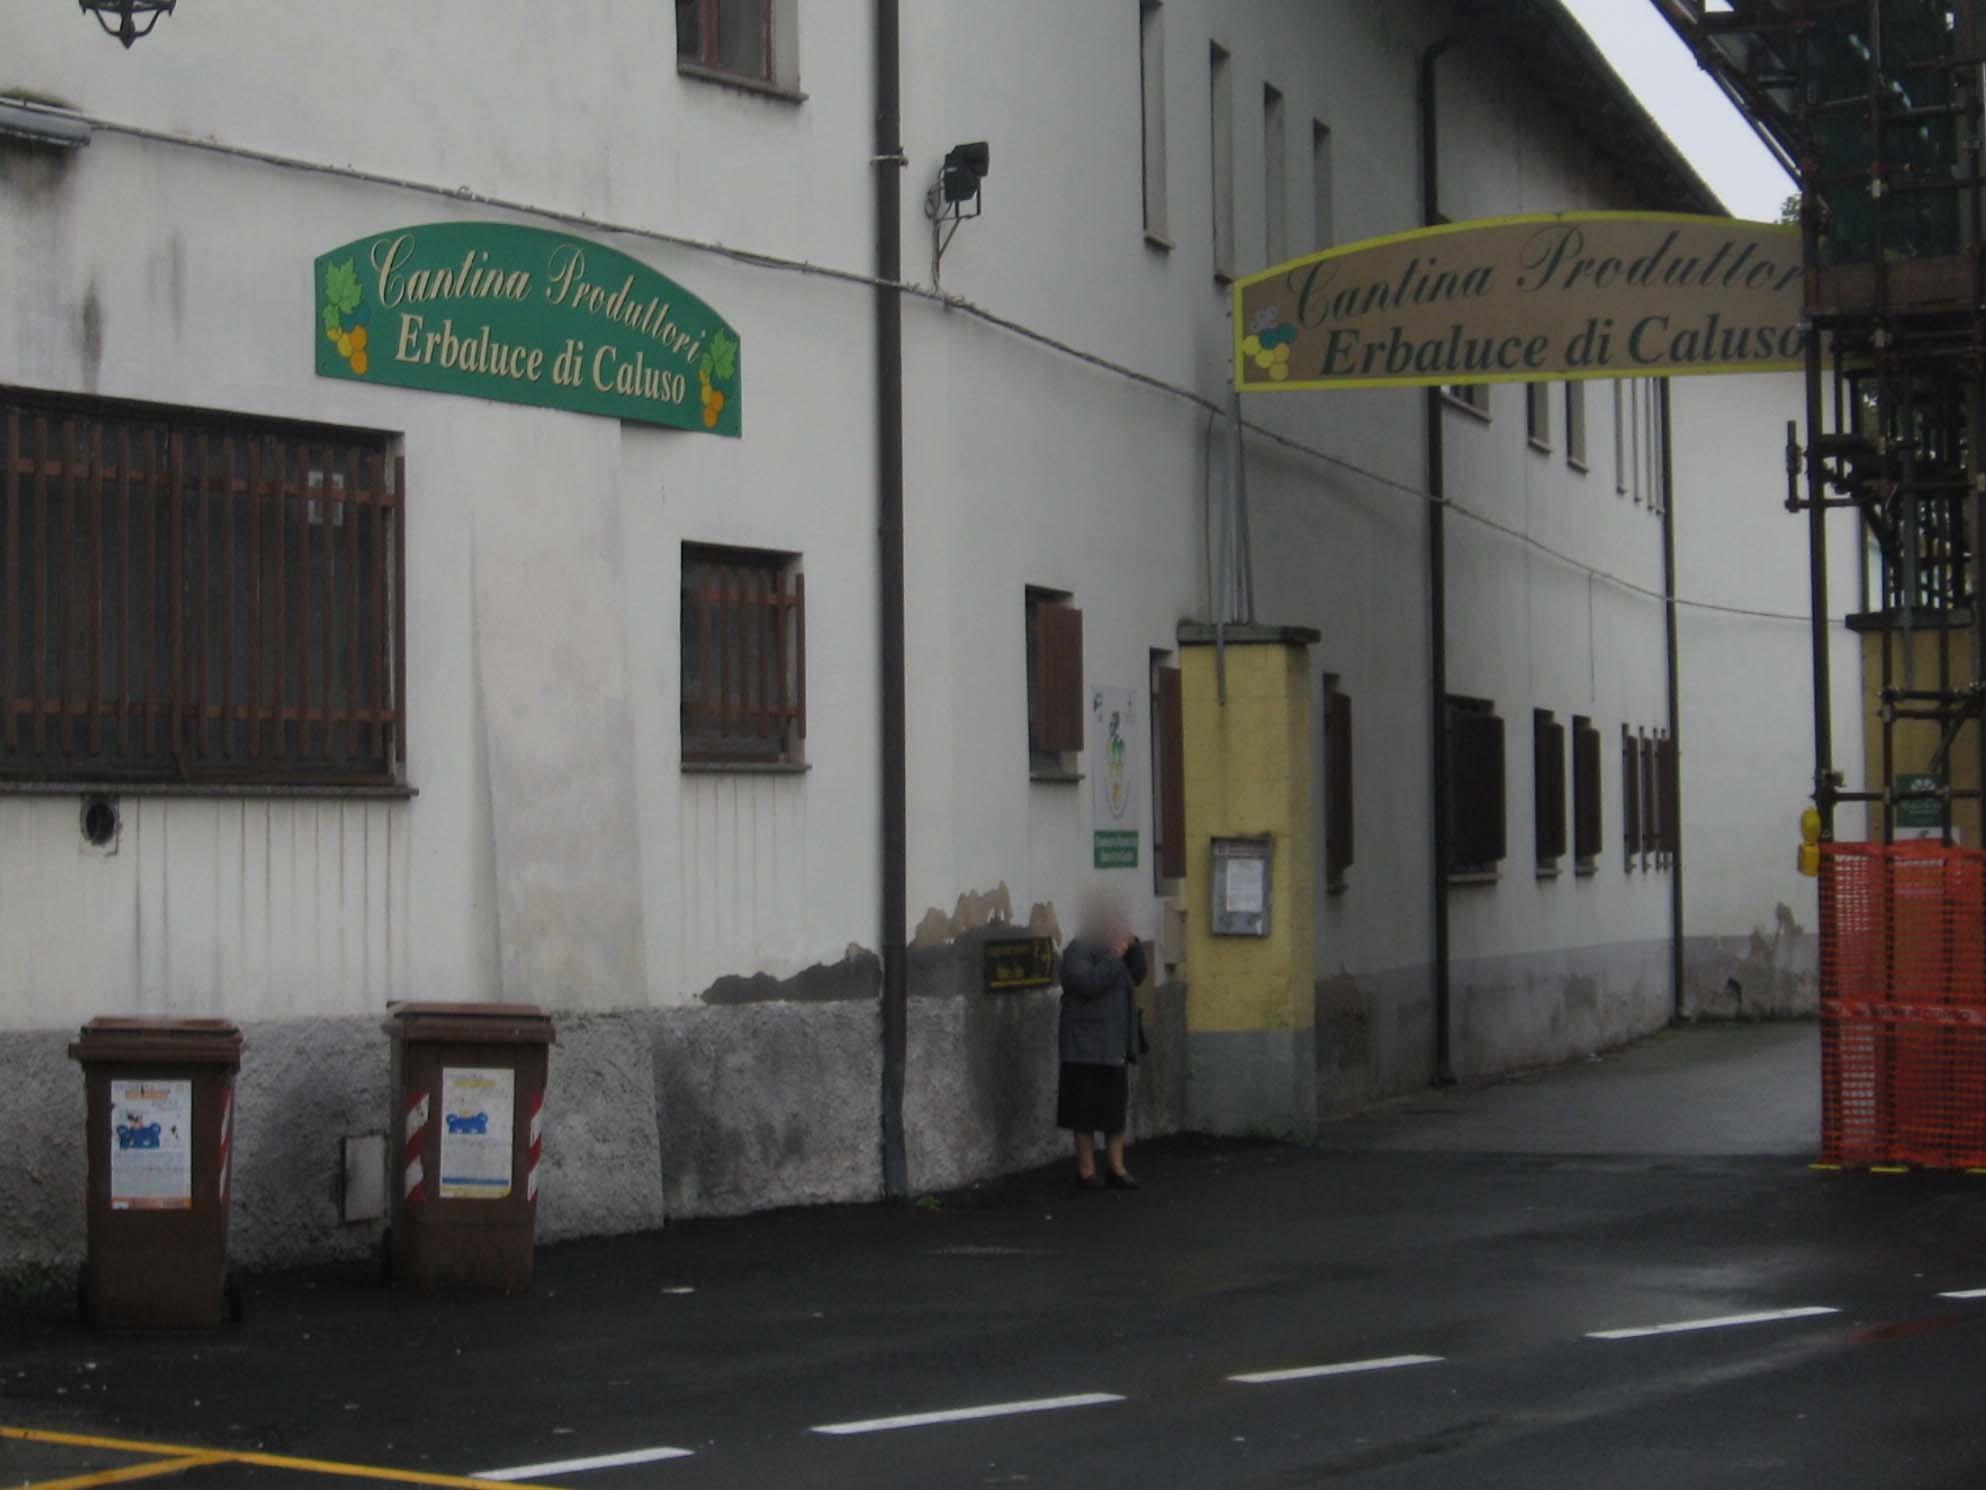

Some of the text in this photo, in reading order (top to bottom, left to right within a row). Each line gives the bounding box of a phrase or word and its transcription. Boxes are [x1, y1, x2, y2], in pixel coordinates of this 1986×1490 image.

[370, 233, 707, 364] Cantina Produttori
[1286, 226, 1803, 329] Cantina Produttor
[394, 313, 687, 405] Erbaluce di Caluso
[1318, 313, 1802, 376] Erbaluce di Caluso
